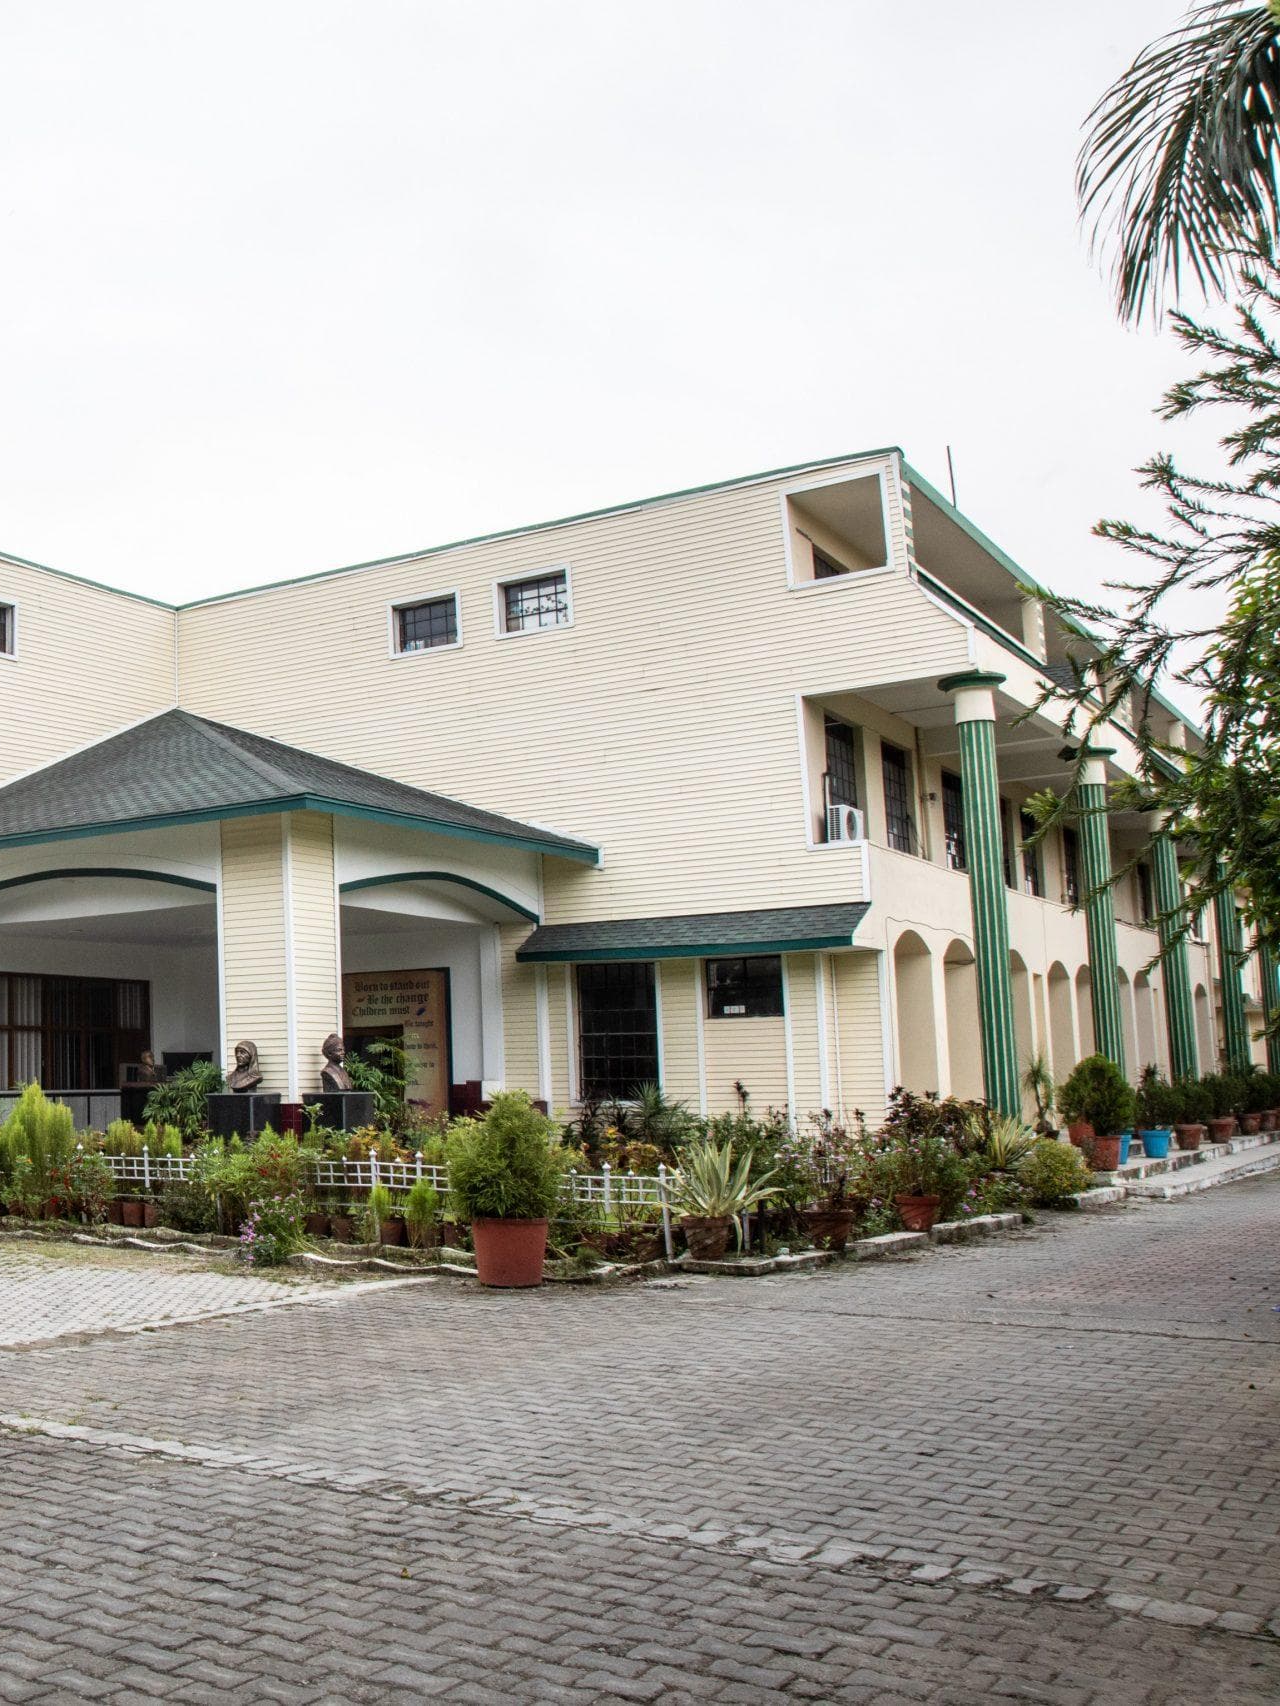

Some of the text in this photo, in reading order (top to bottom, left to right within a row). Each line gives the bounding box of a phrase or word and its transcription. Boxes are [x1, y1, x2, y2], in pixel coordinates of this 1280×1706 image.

[354, 980, 430, 992] Born to stand out
[367, 992, 429, 1004] Be the change
[352, 1006, 410, 1016] Children must
